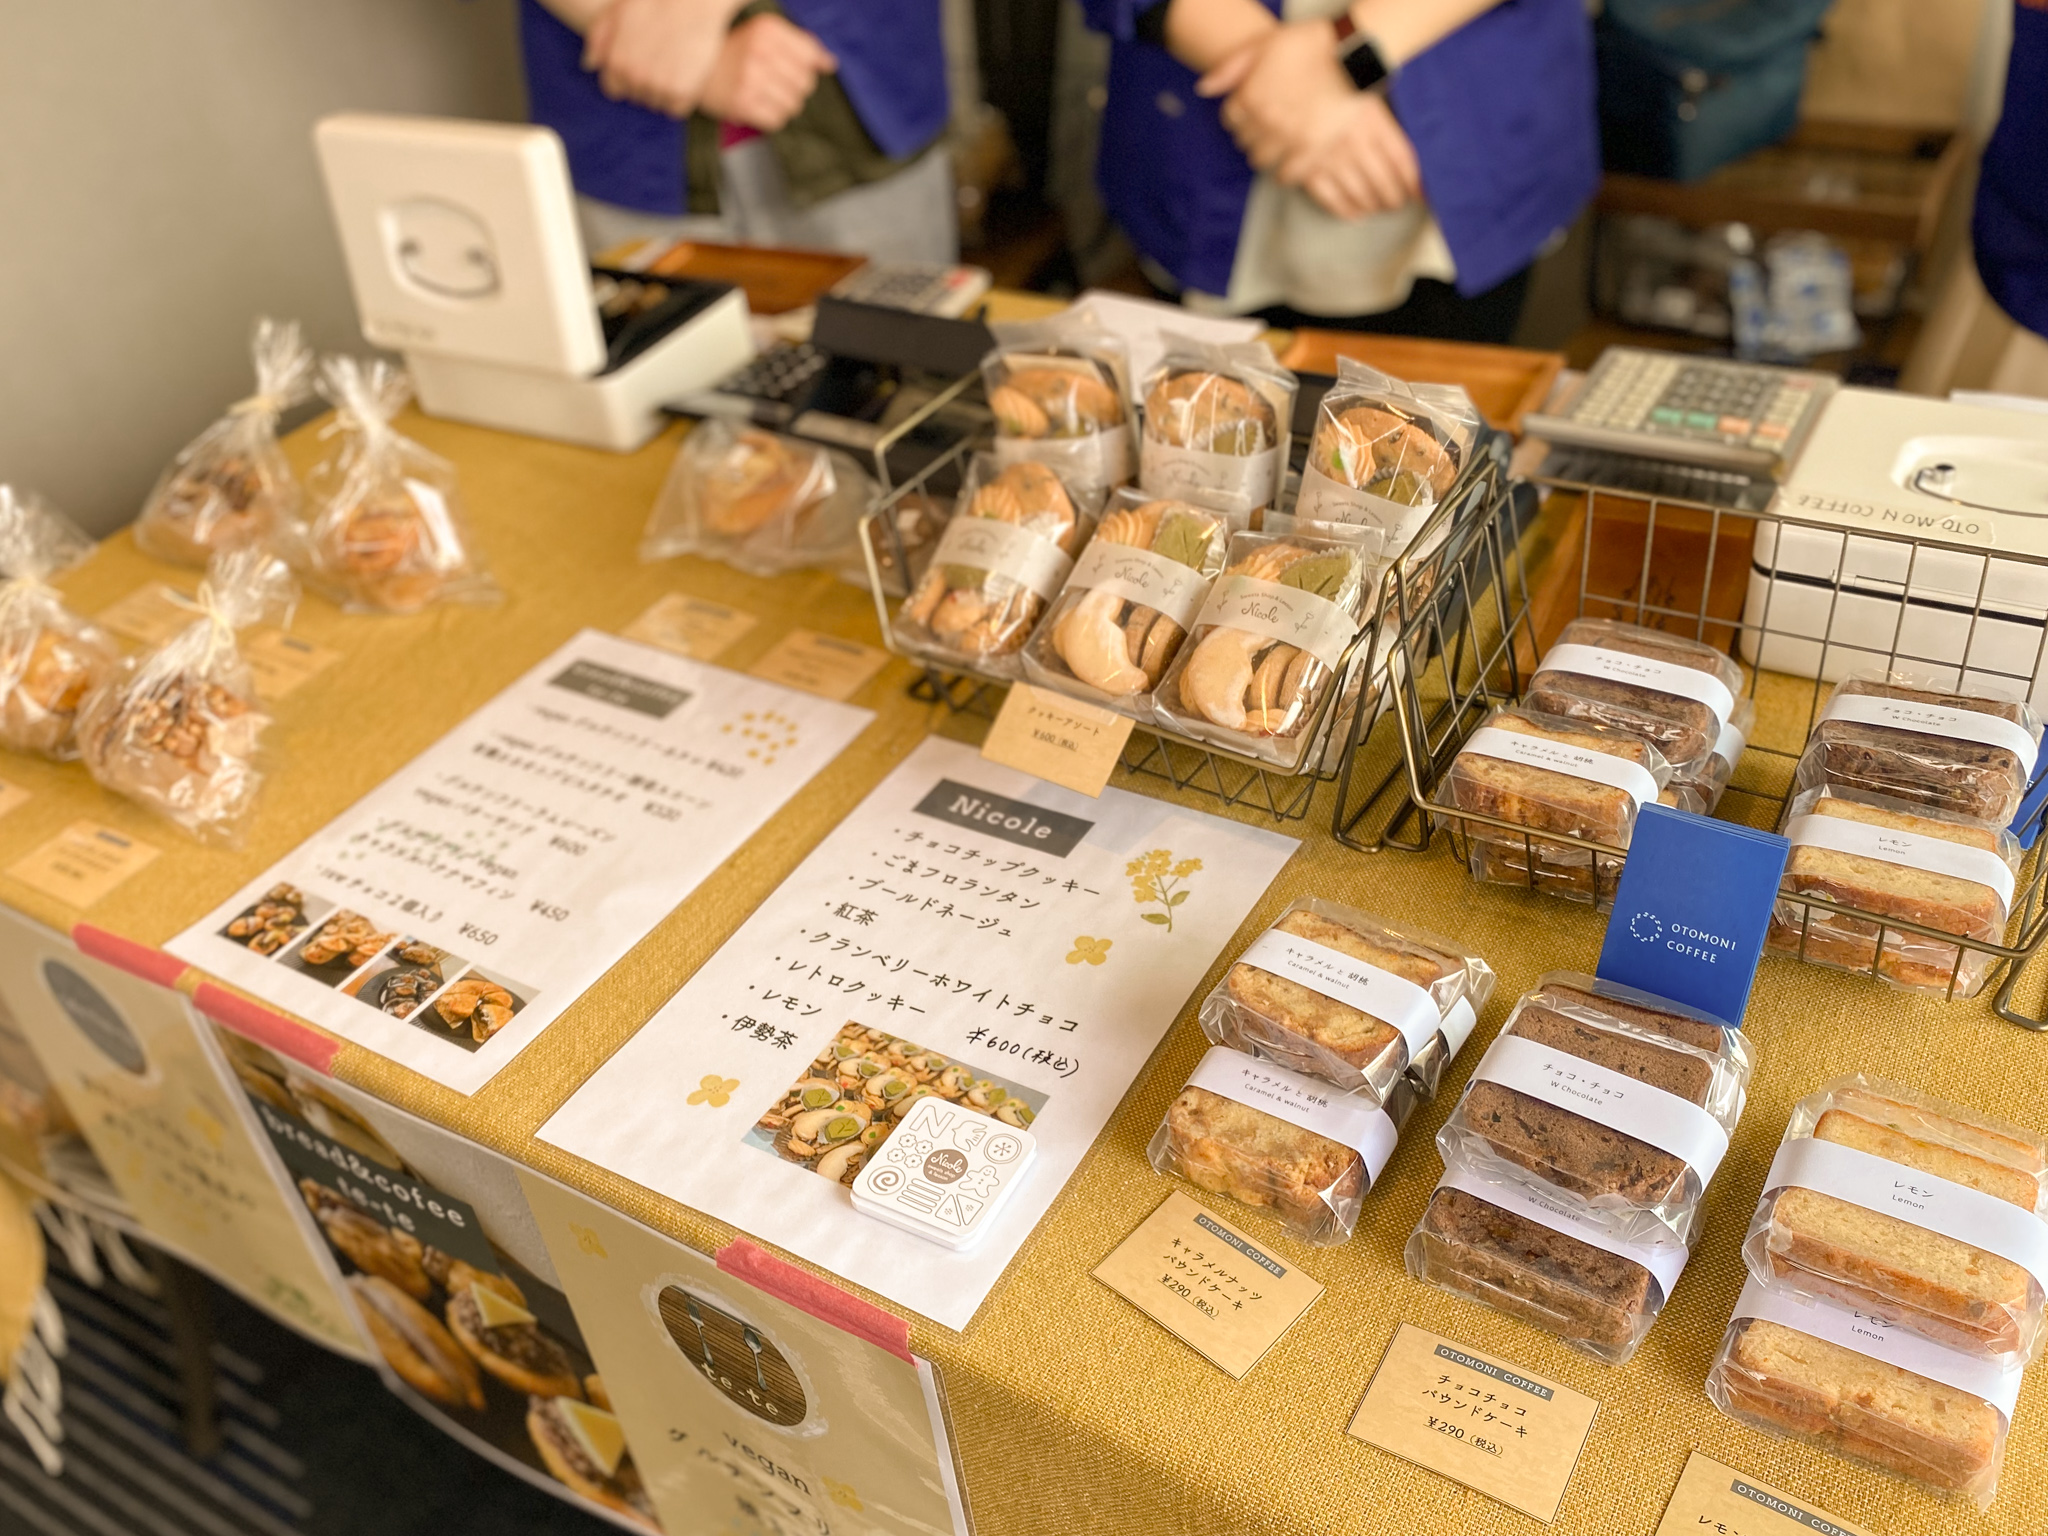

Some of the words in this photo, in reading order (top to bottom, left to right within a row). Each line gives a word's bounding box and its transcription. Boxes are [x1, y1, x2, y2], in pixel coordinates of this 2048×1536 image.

[1114, 565, 1150, 589] Nicole
[1241, 601, 1279, 623] Nicole
[1612, 667, 1647, 679] Chocolate
[1902, 716, 1941, 727] Chocolate
[1515, 749, 1544, 760] Caramel
[1553, 758, 1579, 768] walnut
[948, 794, 1053, 840] Nicole
[1878, 836, 1913, 848] レモン
[1878, 845, 1907, 855] Lemon
[903, 831, 1101, 896] チョコチップクッキー
[883, 854, 1041, 910] ごまフロランタン
[832, 901, 880, 928] 紅茶
[858, 877, 1012, 938] ブールドネージュ
[458, 921, 500, 947] ¥650
[1671, 923, 1737, 951] OTOMONI
[1666, 940, 1718, 963] COFFEE
[787, 959, 926, 1014] レトロクッキー
[809, 931, 1080, 1033] クランベリーホワイトチョコ
[1287, 960, 1317, 976] Caramel
[1324, 975, 1351, 990] walnut
[761, 988, 823, 1018] レモン
[730, 1013, 799, 1051] 伊勢茶
[1542, 1063, 1625, 1099] チョコ・チョコ
[1550, 1080, 1560, 1088] W
[1561, 1085, 1603, 1106] Chocolate
[1244, 1083, 1275, 1102] Caramel
[1284, 1099, 1310, 1113] walnut
[930, 1152, 963, 1174] Nicole
[1892, 1194, 1925, 1210] Lemon
[1894, 1181, 1935, 1198] レモン
[1539, 1201, 1581, 1222] Chocolate
[1198, 1216, 1243, 1249] OTOMONI
[1246, 1248, 1282, 1275] COFFEE
[1163, 1254, 1244, 1311] パウンドケーキ
[1171, 1237, 1263, 1301] キャラメルナッツ
[1851, 1325, 1884, 1342] Lemon
[1440, 1348, 1498, 1376] OTOMONI
[1503, 1373, 1549, 1397] COFFEE
[1437, 1374, 1527, 1417] チョコチョコ
[1422, 1389, 1528, 1438] パウンドケーキ
[722, 1431, 812, 1497] vegan
[1737, 1484, 1804, 1521] OTOMONI
